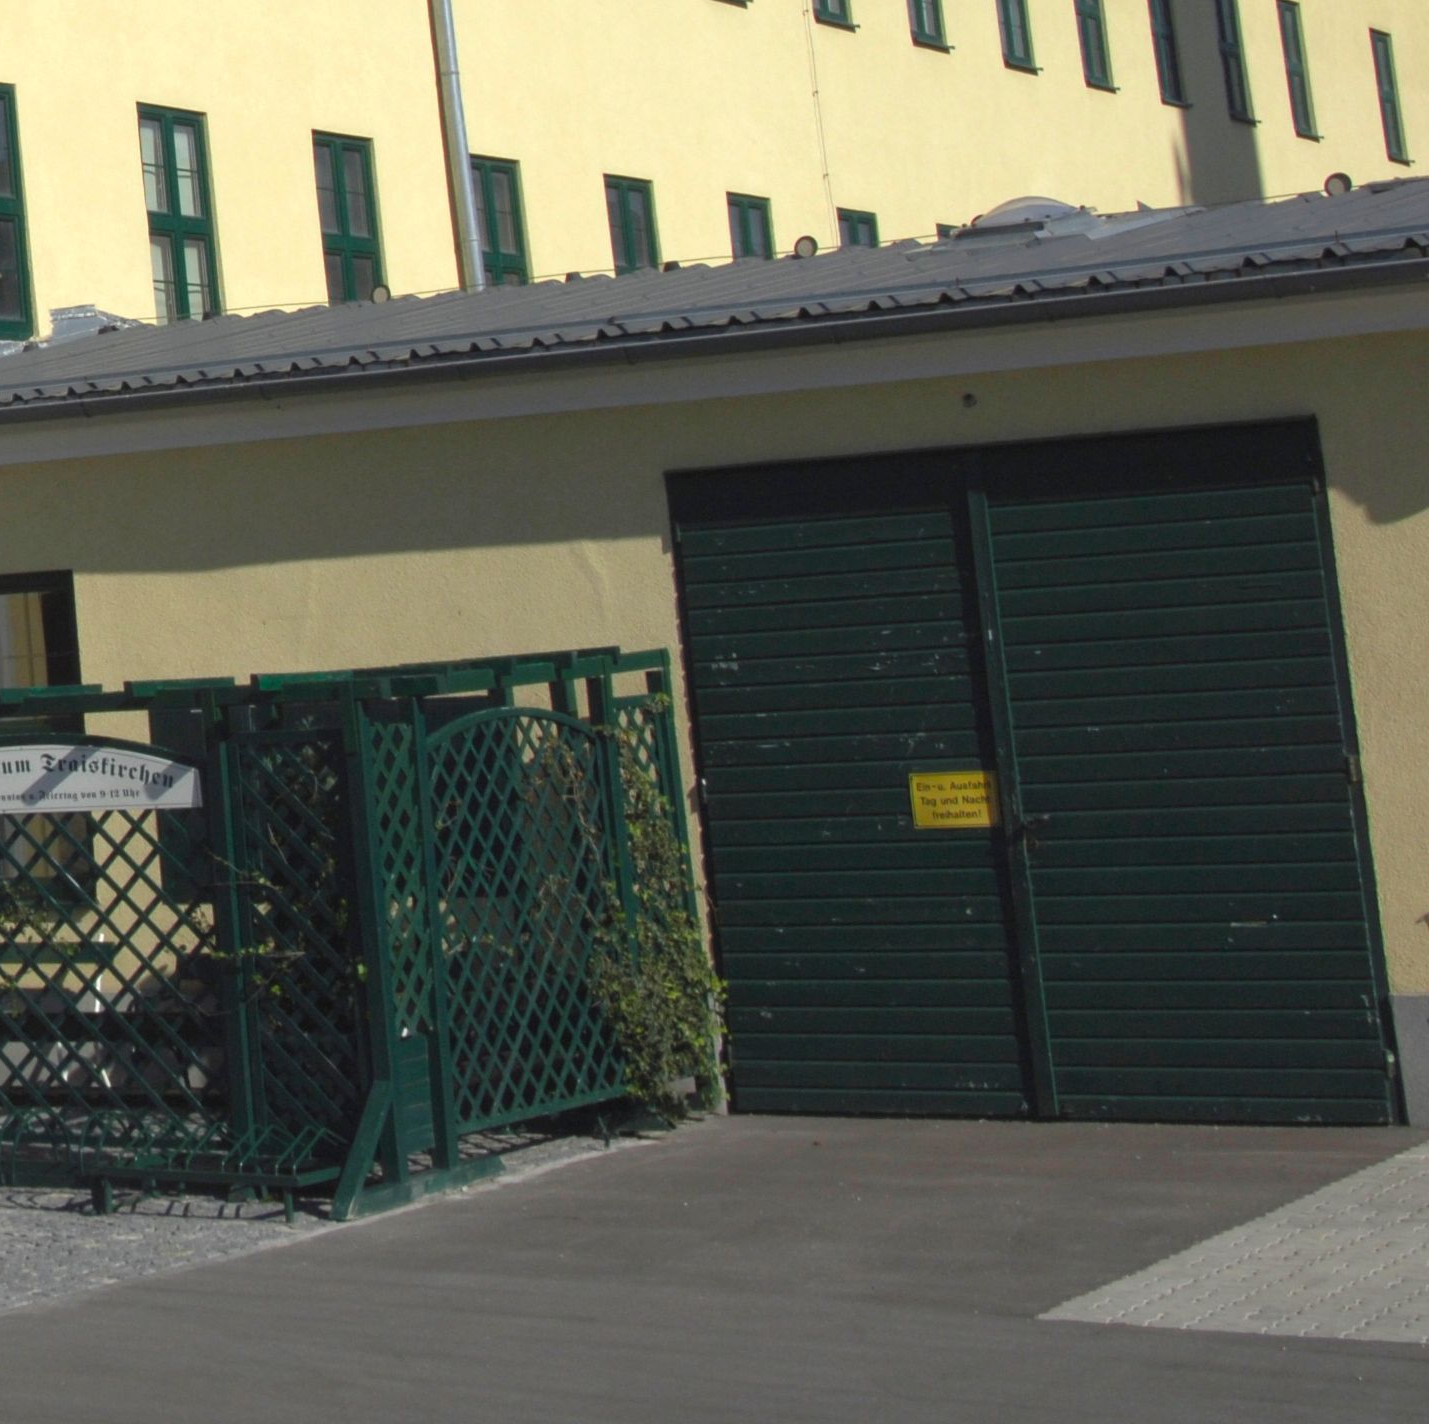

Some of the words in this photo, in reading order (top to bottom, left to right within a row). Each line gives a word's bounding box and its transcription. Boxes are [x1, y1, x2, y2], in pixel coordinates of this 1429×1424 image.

[40, 752, 174, 788] Traiskirchen
[920, 796, 937, 807] Tag
[940, 796, 958, 805] und
[962, 794, 991, 805] Nacht
